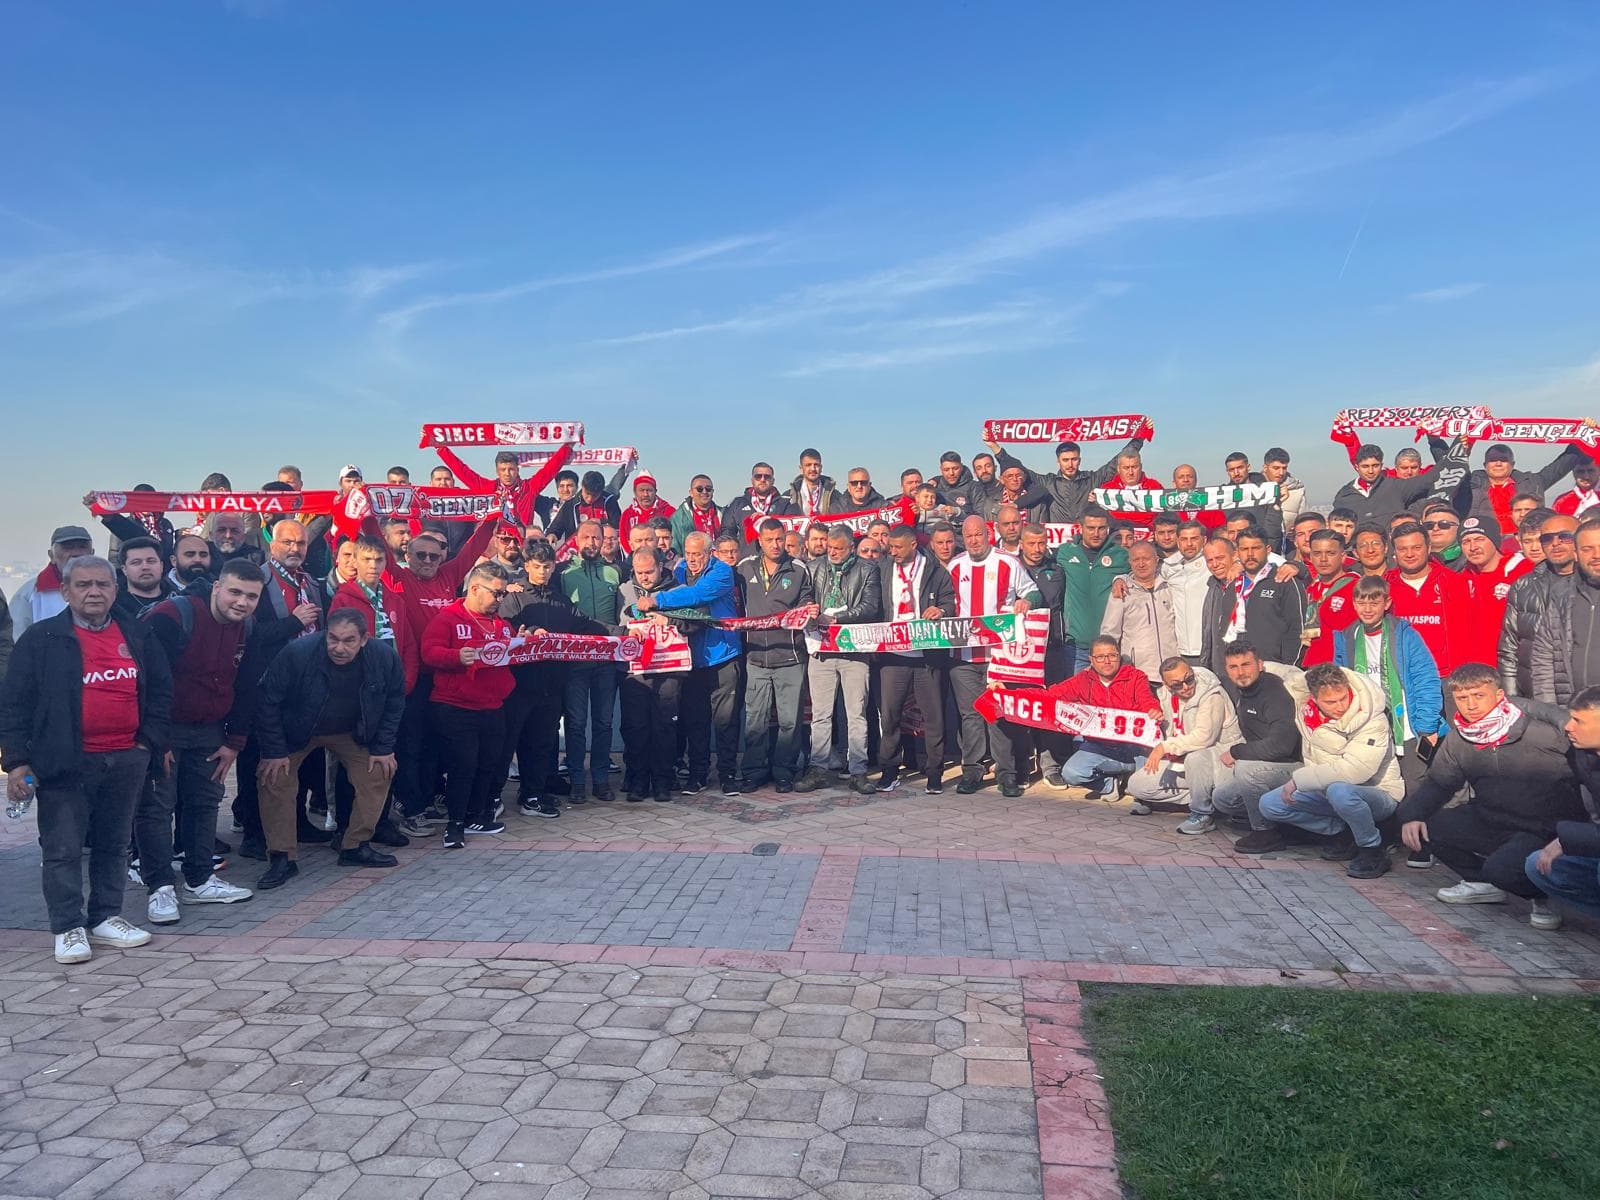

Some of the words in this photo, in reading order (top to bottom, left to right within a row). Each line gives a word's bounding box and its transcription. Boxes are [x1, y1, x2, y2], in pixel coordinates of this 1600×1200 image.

[1347, 408, 1380, 421] RED
[1385, 405, 1472, 419] SOLDIERS
[432, 426, 485, 442] SINCE
[1447, 419, 1493, 436] 07
[517, 446, 623, 463] ANTASPOR
[168, 494, 283, 512] ANTALYA
[367, 486, 414, 515] 07
[428, 494, 502, 520] GENÇL
[1094, 487, 1165, 513] UNI
[1205, 481, 1279, 511] HM
[1260, 589, 1275, 598] EA7
[1400, 615, 1441, 625] YASPOR
[508, 639, 619, 657] ANTALYASPOR
[543, 653, 565, 661] NEVER
[568, 653, 588, 661] WALK
[590, 652, 610, 660] ALONE
